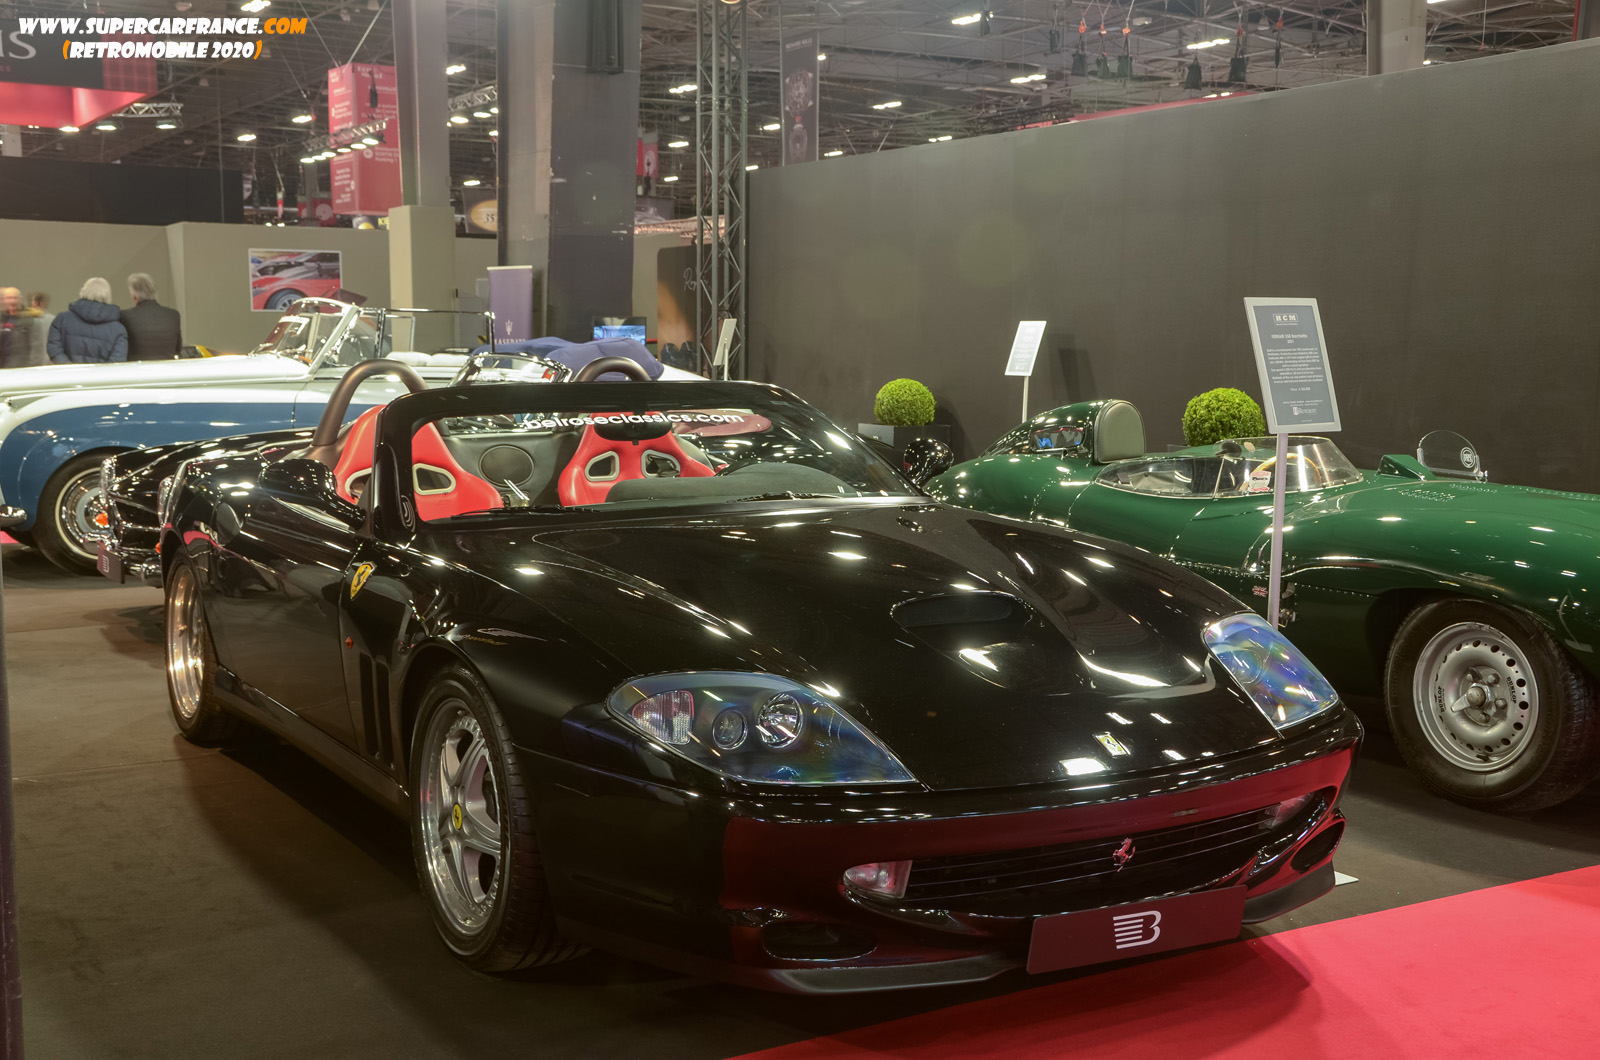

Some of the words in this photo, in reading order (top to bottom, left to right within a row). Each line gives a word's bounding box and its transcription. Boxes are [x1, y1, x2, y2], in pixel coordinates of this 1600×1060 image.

[525, 412, 745, 430] belroseclassics.com
[1437, 685, 1445, 713] DUNLOP
[1506, 676, 1517, 704] DUNLOP
